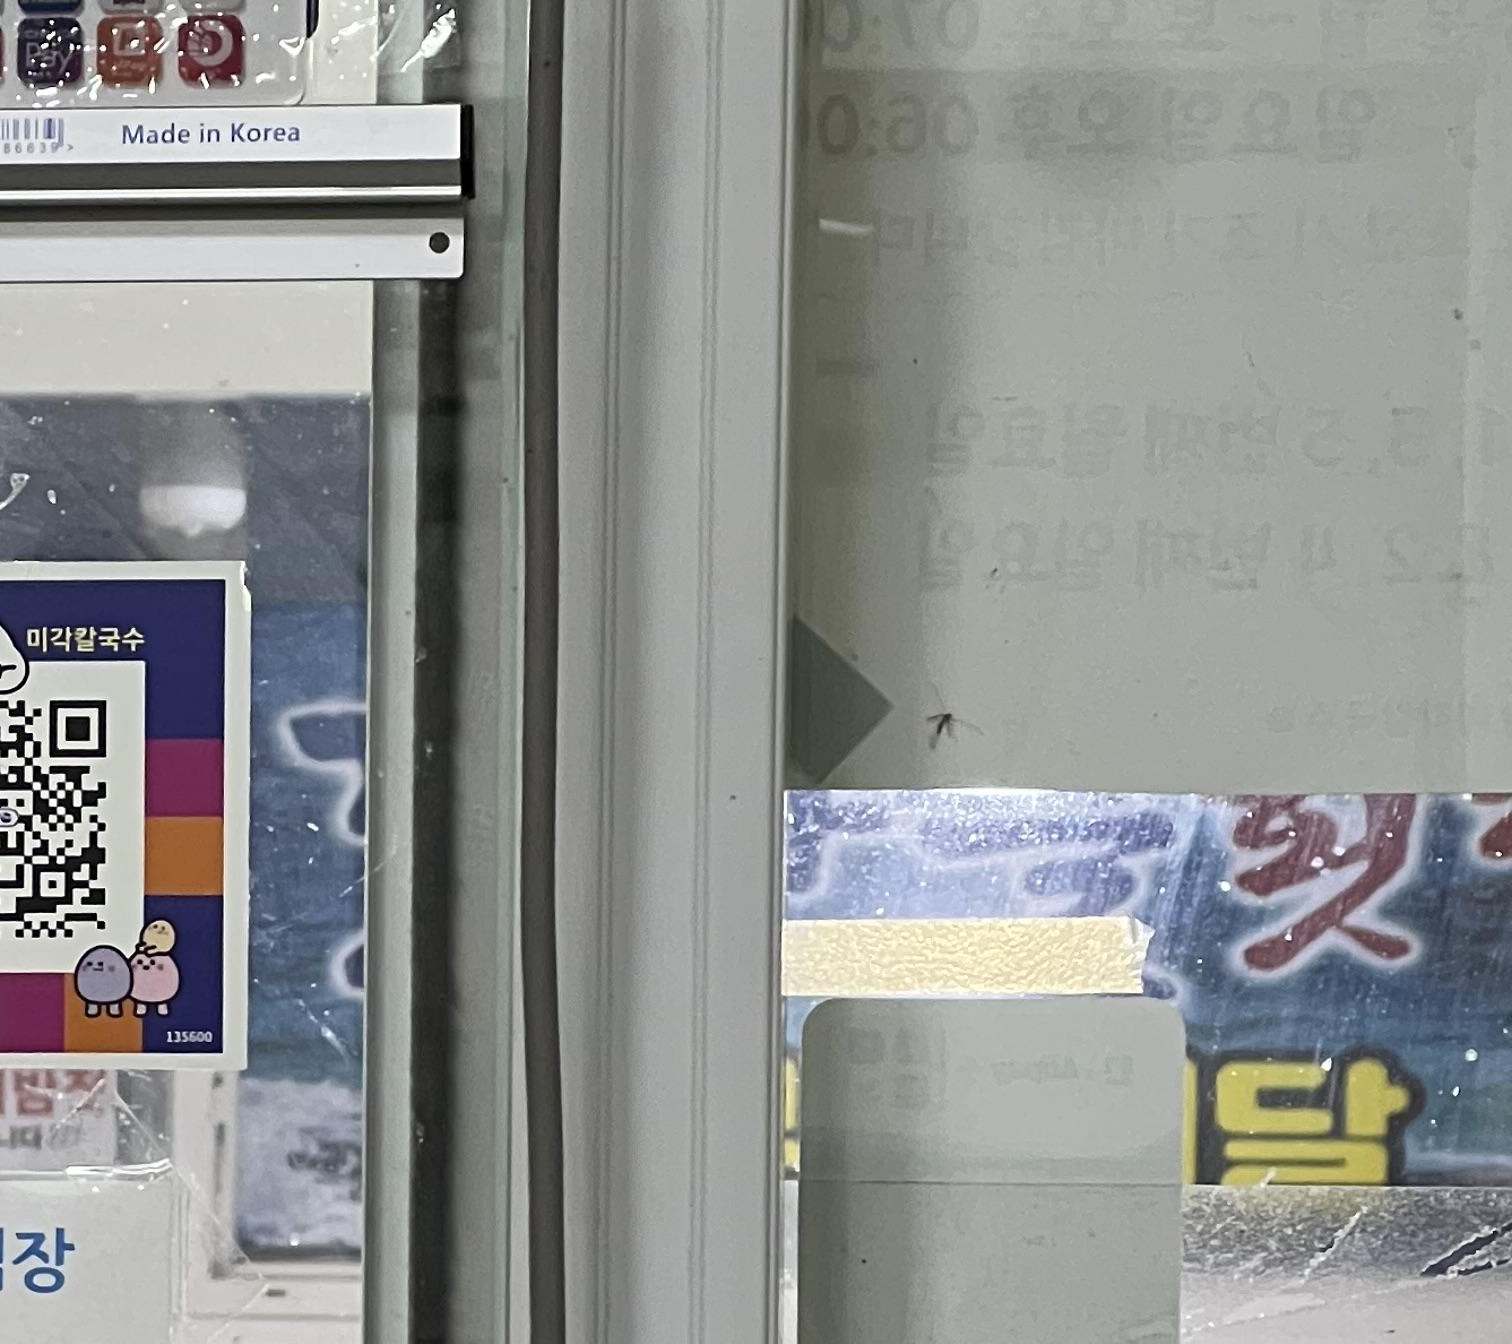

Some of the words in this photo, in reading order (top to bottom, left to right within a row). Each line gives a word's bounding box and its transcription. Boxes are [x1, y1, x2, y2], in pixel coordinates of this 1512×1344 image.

[121, 123, 190, 146] Made
[199, 122, 221, 144] in
[231, 122, 301, 143] Korea
[26, 626, 145, 652] 미각칼국수
[166, 1031, 213, 1043] 135600
